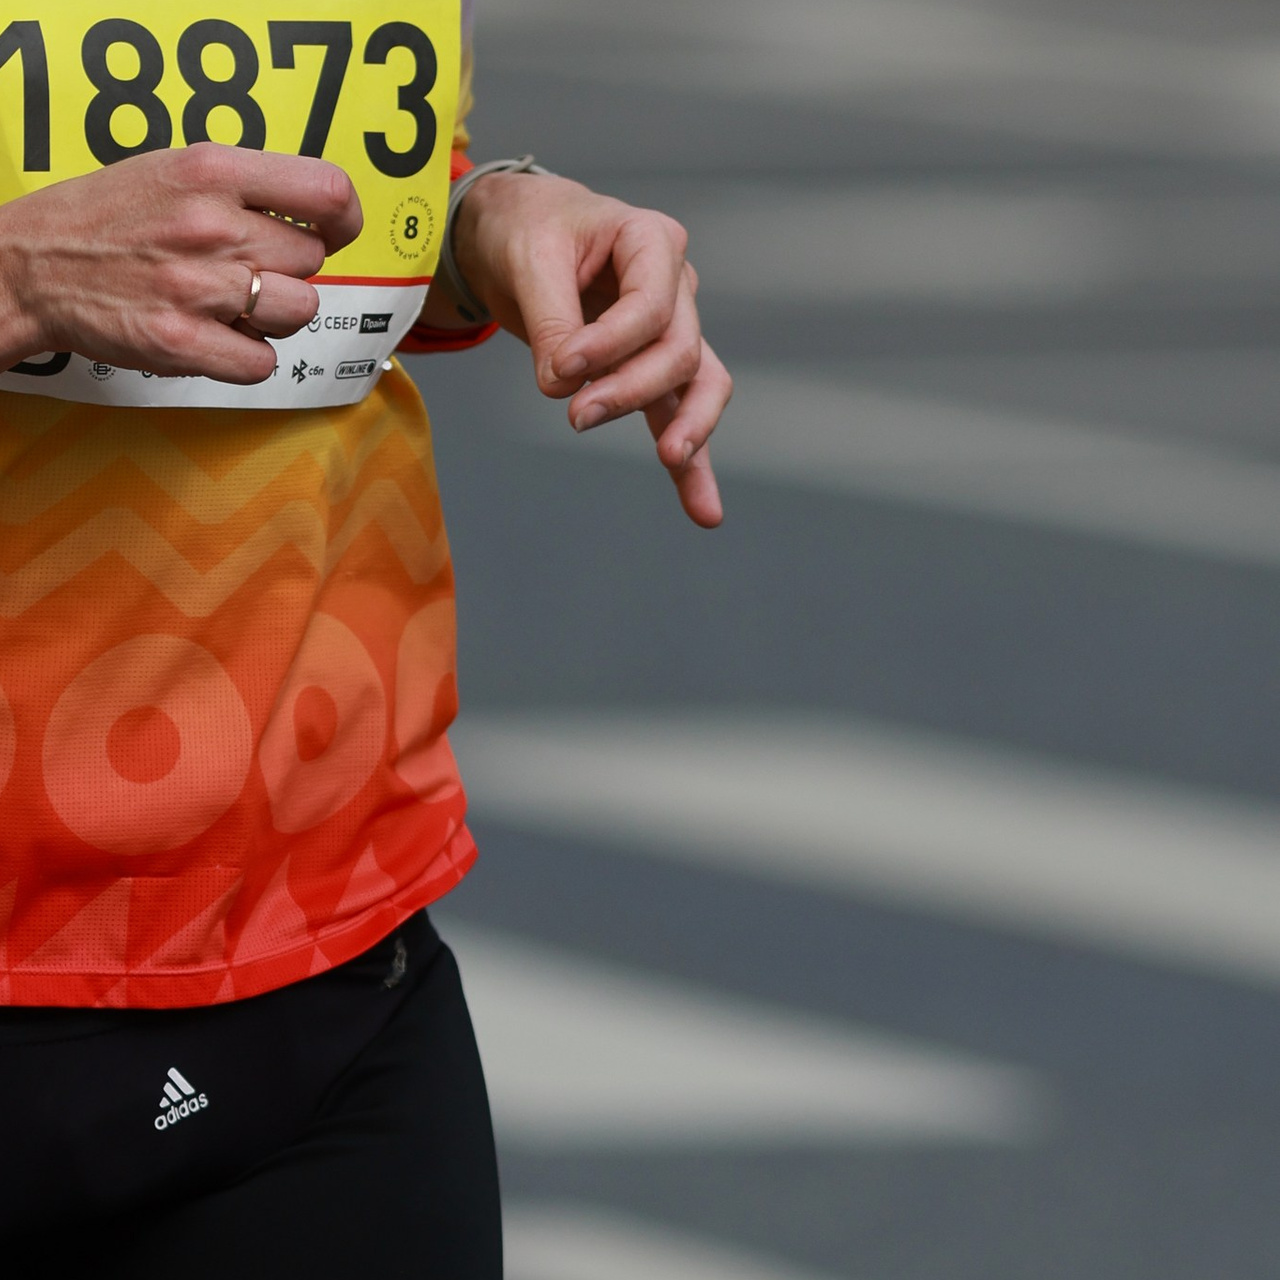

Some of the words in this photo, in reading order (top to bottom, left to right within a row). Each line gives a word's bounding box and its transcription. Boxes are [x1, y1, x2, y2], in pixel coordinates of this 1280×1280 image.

[404, 215, 419, 240] 8
[324, 316, 358, 330] СБЕР
[362, 317, 387, 330] Прайм
[308, 365, 324, 376] сбп
[338, 363, 368, 376] WINLINE
[154, 1092, 209, 1131] adidas
